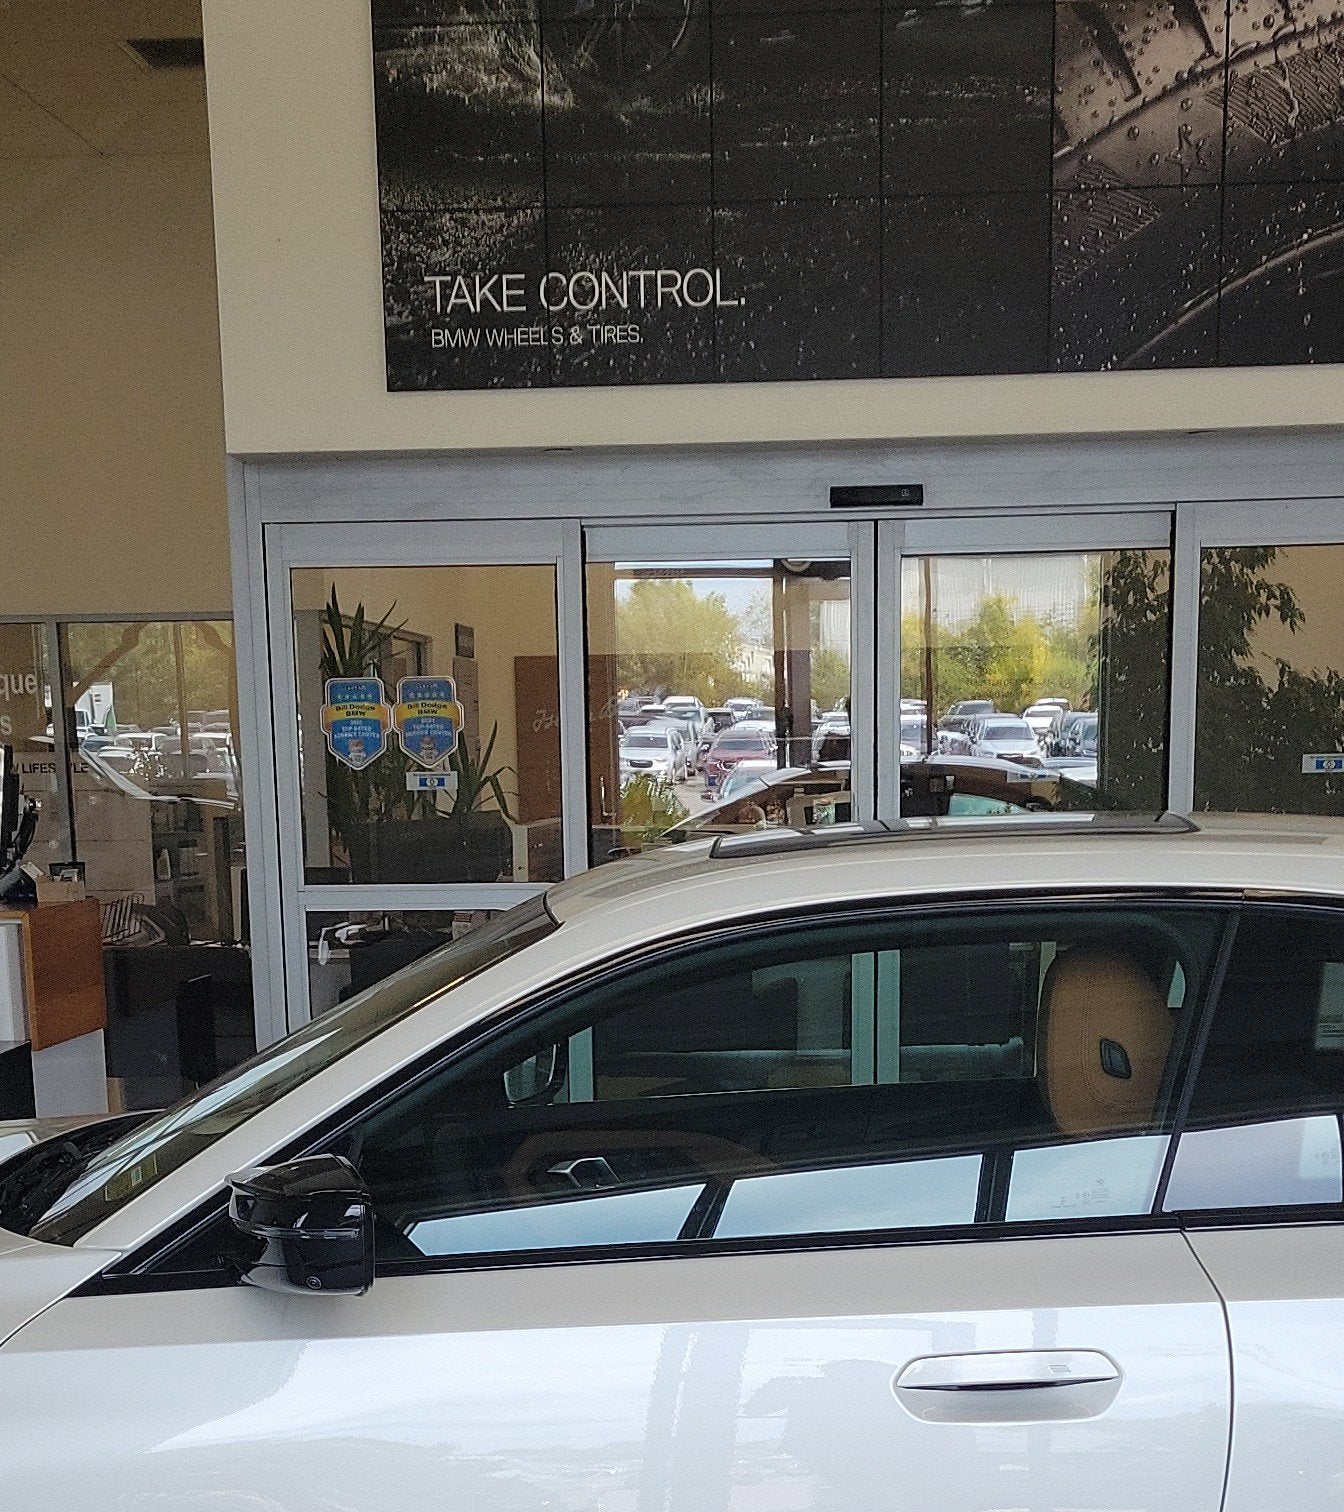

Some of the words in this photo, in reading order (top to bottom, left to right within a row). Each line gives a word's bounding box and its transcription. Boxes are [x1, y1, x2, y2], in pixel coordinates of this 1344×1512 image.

[423, 273, 527, 314] TAKE
[539, 267, 746, 311] CONTROL.
[431, 328, 481, 349] BMW
[485, 327, 564, 348] WHEELS
[569, 325, 583, 345] &
